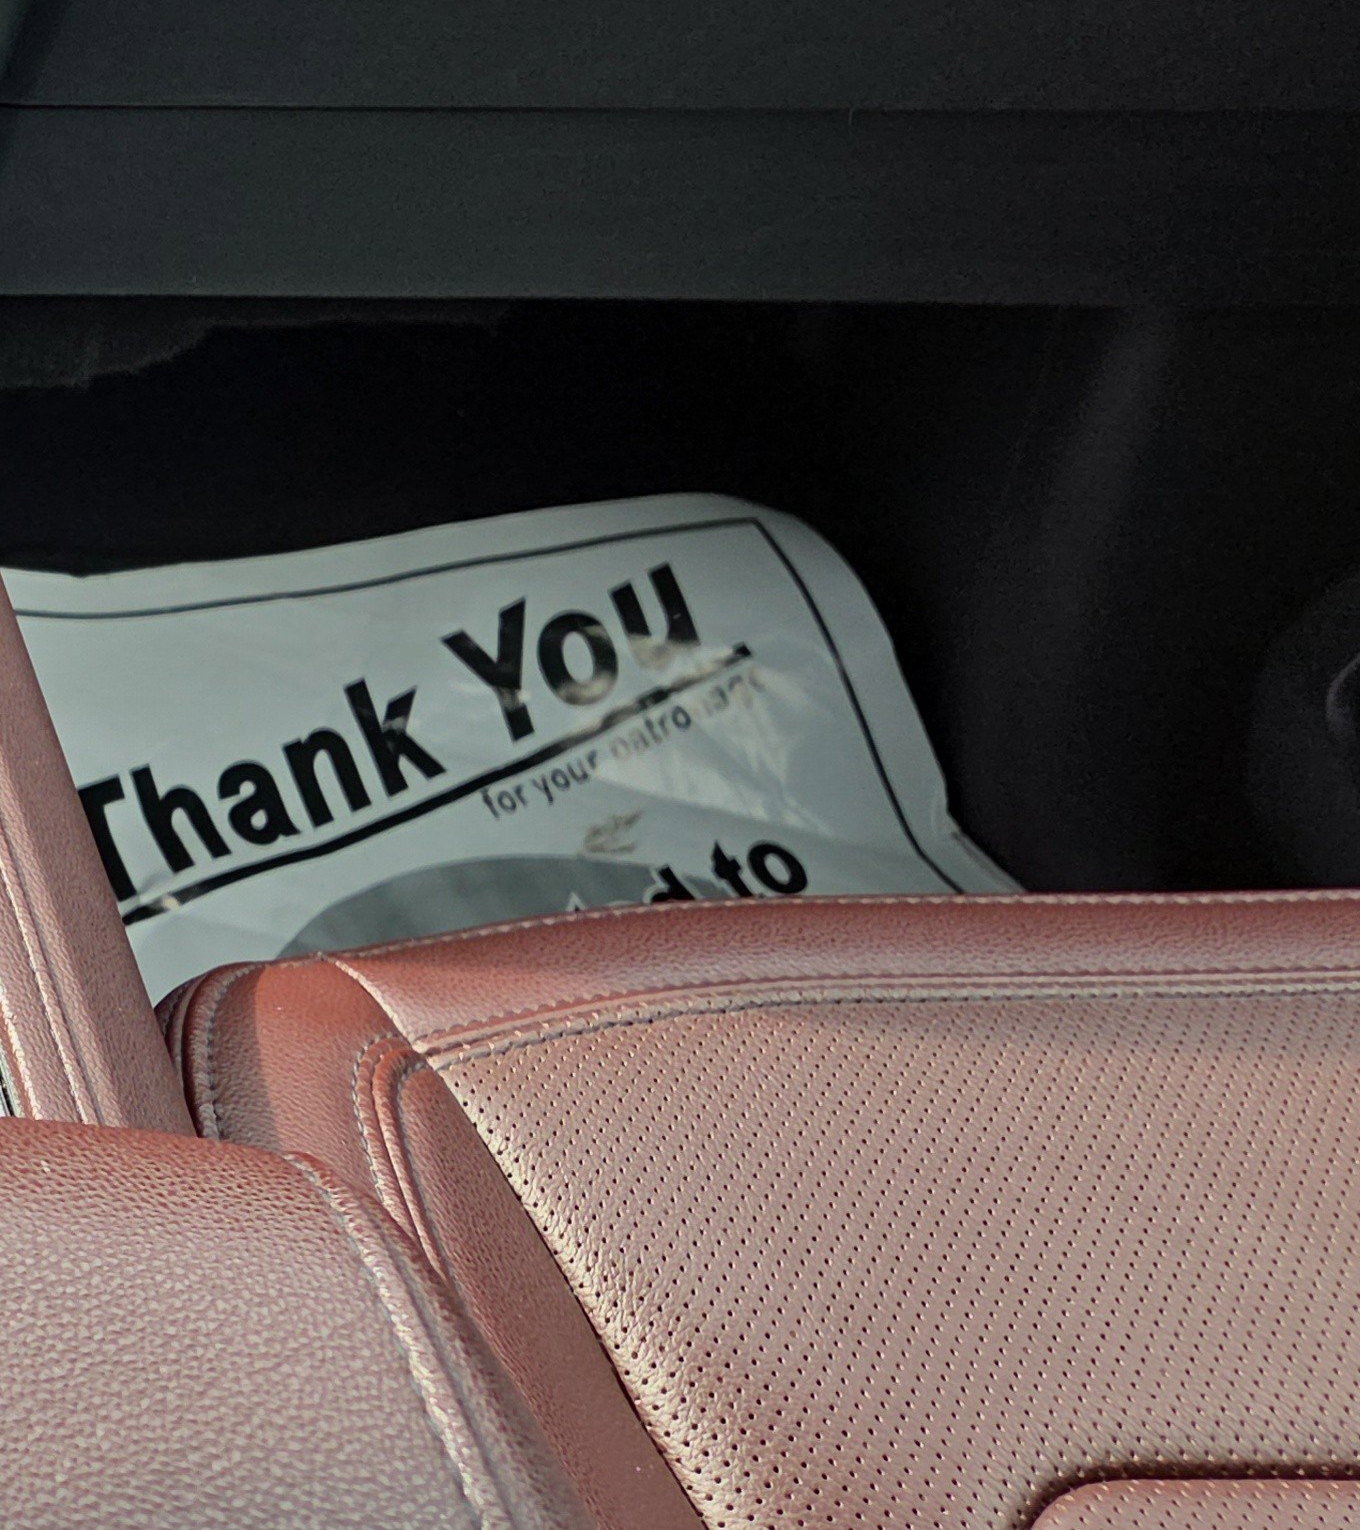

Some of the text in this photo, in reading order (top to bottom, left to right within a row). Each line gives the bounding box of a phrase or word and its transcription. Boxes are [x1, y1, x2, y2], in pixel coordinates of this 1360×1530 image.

[78, 562, 703, 902] Thank You
[481, 785, 529, 819] for
[533, 748, 599, 805] your
[710, 838, 809, 899] to
